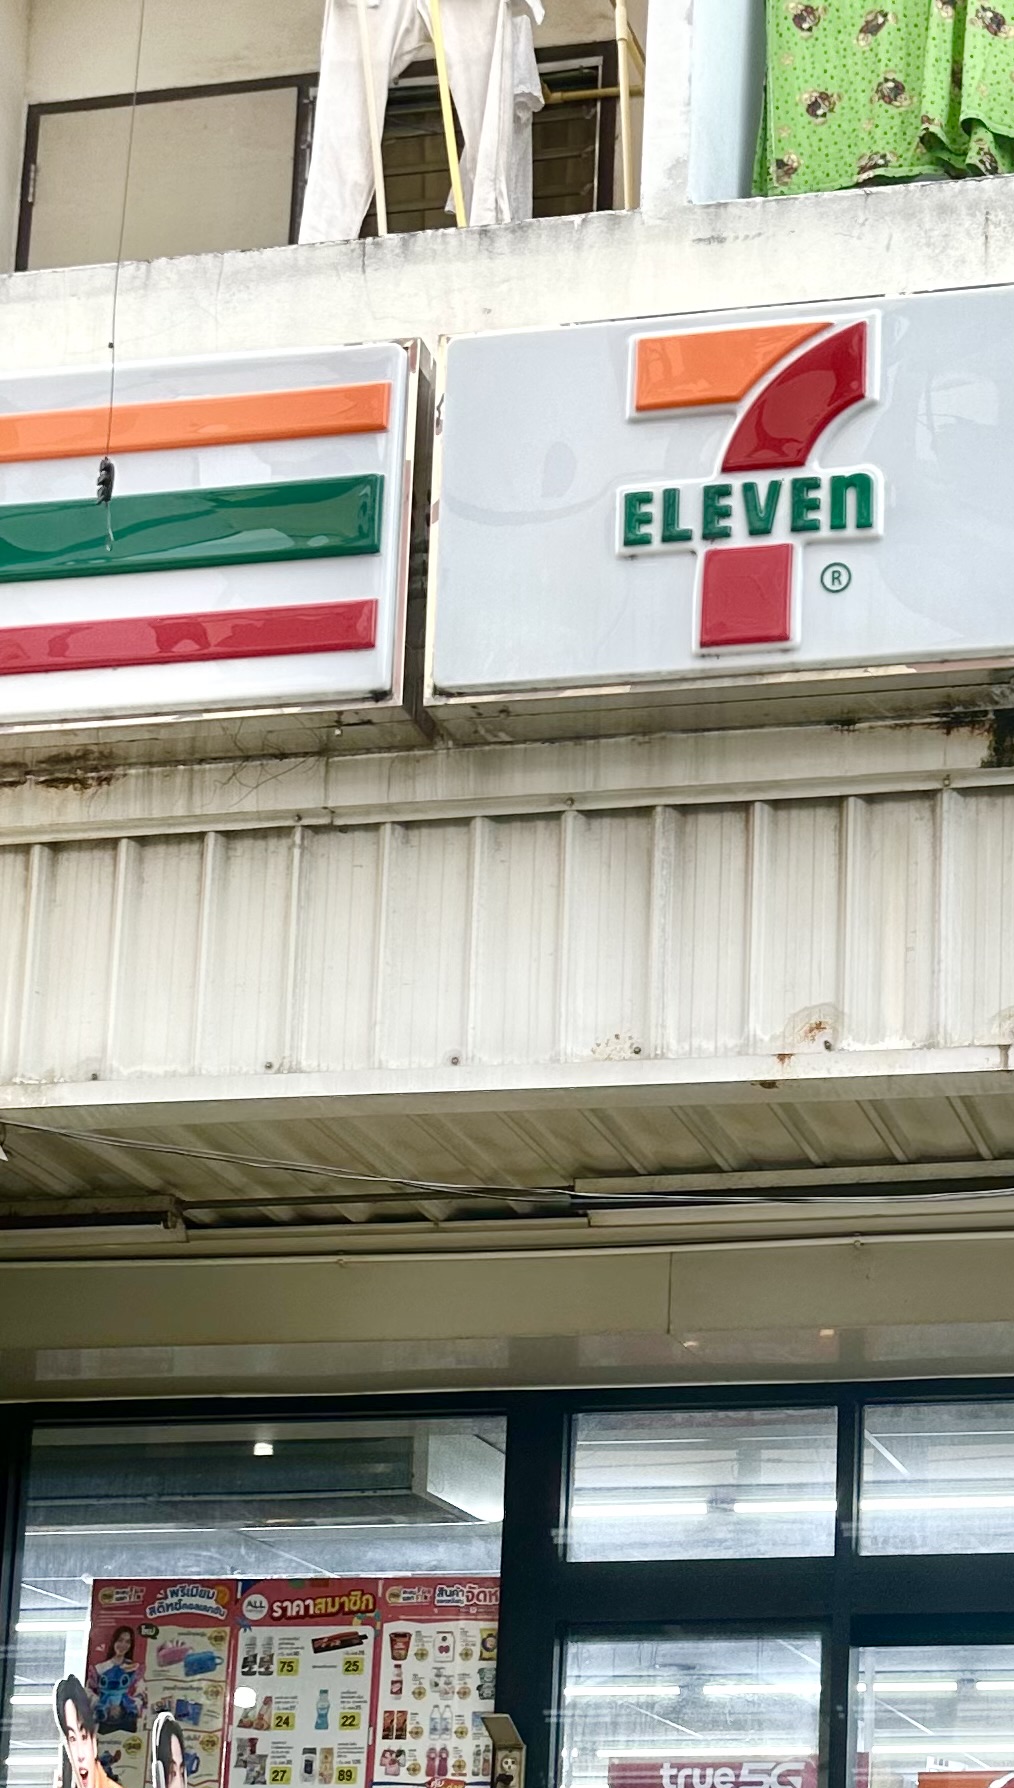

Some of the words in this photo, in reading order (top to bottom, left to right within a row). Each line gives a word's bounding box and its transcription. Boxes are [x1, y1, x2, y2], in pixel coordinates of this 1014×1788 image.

[271, 1590, 374, 1618] ราคาสมาชิก
[279, 1660, 294, 1673] 75
[344, 1660, 360, 1672] 25
[275, 1716, 290, 1727] 24
[341, 1715, 356, 1727] 22
[271, 1770, 287, 1782] 27
[337, 1769, 353, 1781] 89
